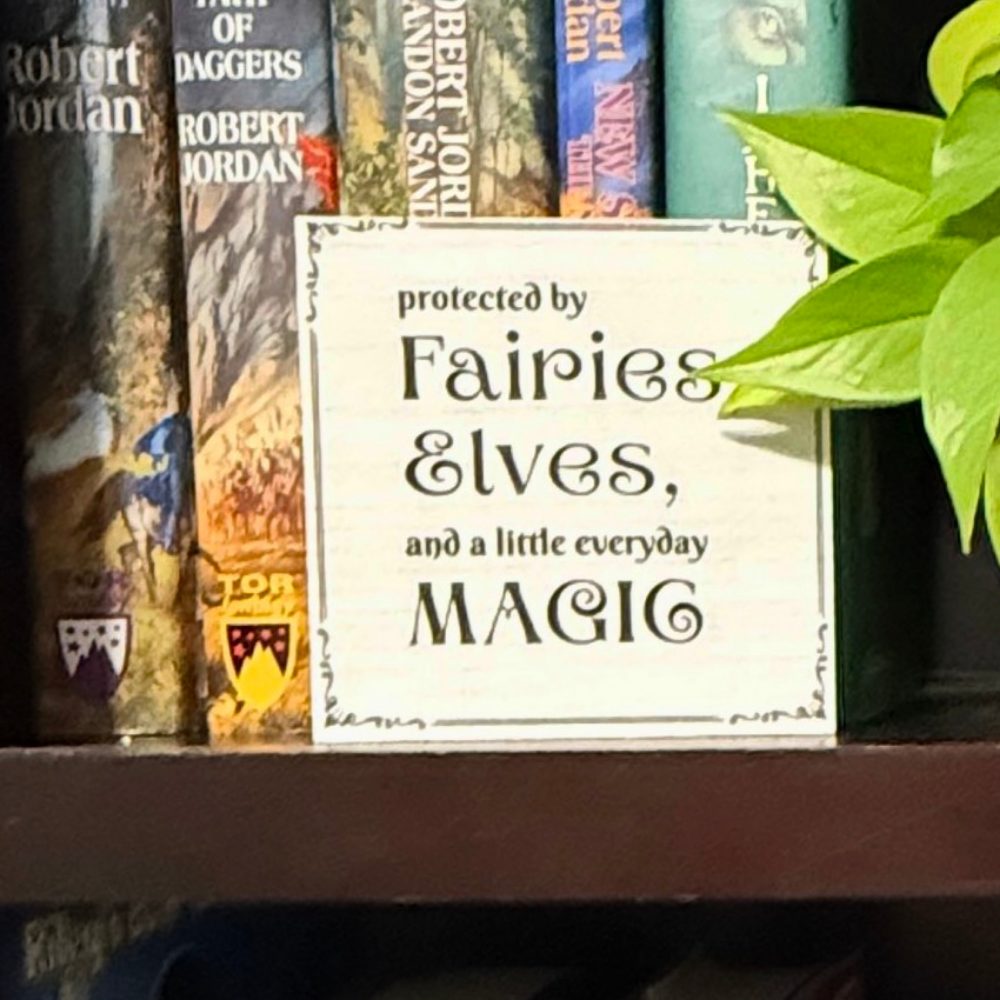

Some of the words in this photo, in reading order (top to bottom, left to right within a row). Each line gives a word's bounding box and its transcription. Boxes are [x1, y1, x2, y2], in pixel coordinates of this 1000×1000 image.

[212, 12, 254, 43] OF
[6, 35, 141, 86] Robert
[175, 49, 303, 83] DAGGERS
[178, 110, 304, 147] ROBERT
[180, 149, 303, 189] JORDAN
[398, 283, 541, 318] protected
[551, 283, 588, 318] by
[401, 330, 722, 402] Fairies
[404, 429, 678, 507] Elves,
[406, 528, 461, 559] and
[470, 535, 486, 556] a
[497, 527, 566, 556] little
[575, 527, 709, 563] everyday
[217, 572, 295, 594] TOR
[409, 578, 704, 645] MAGIC
